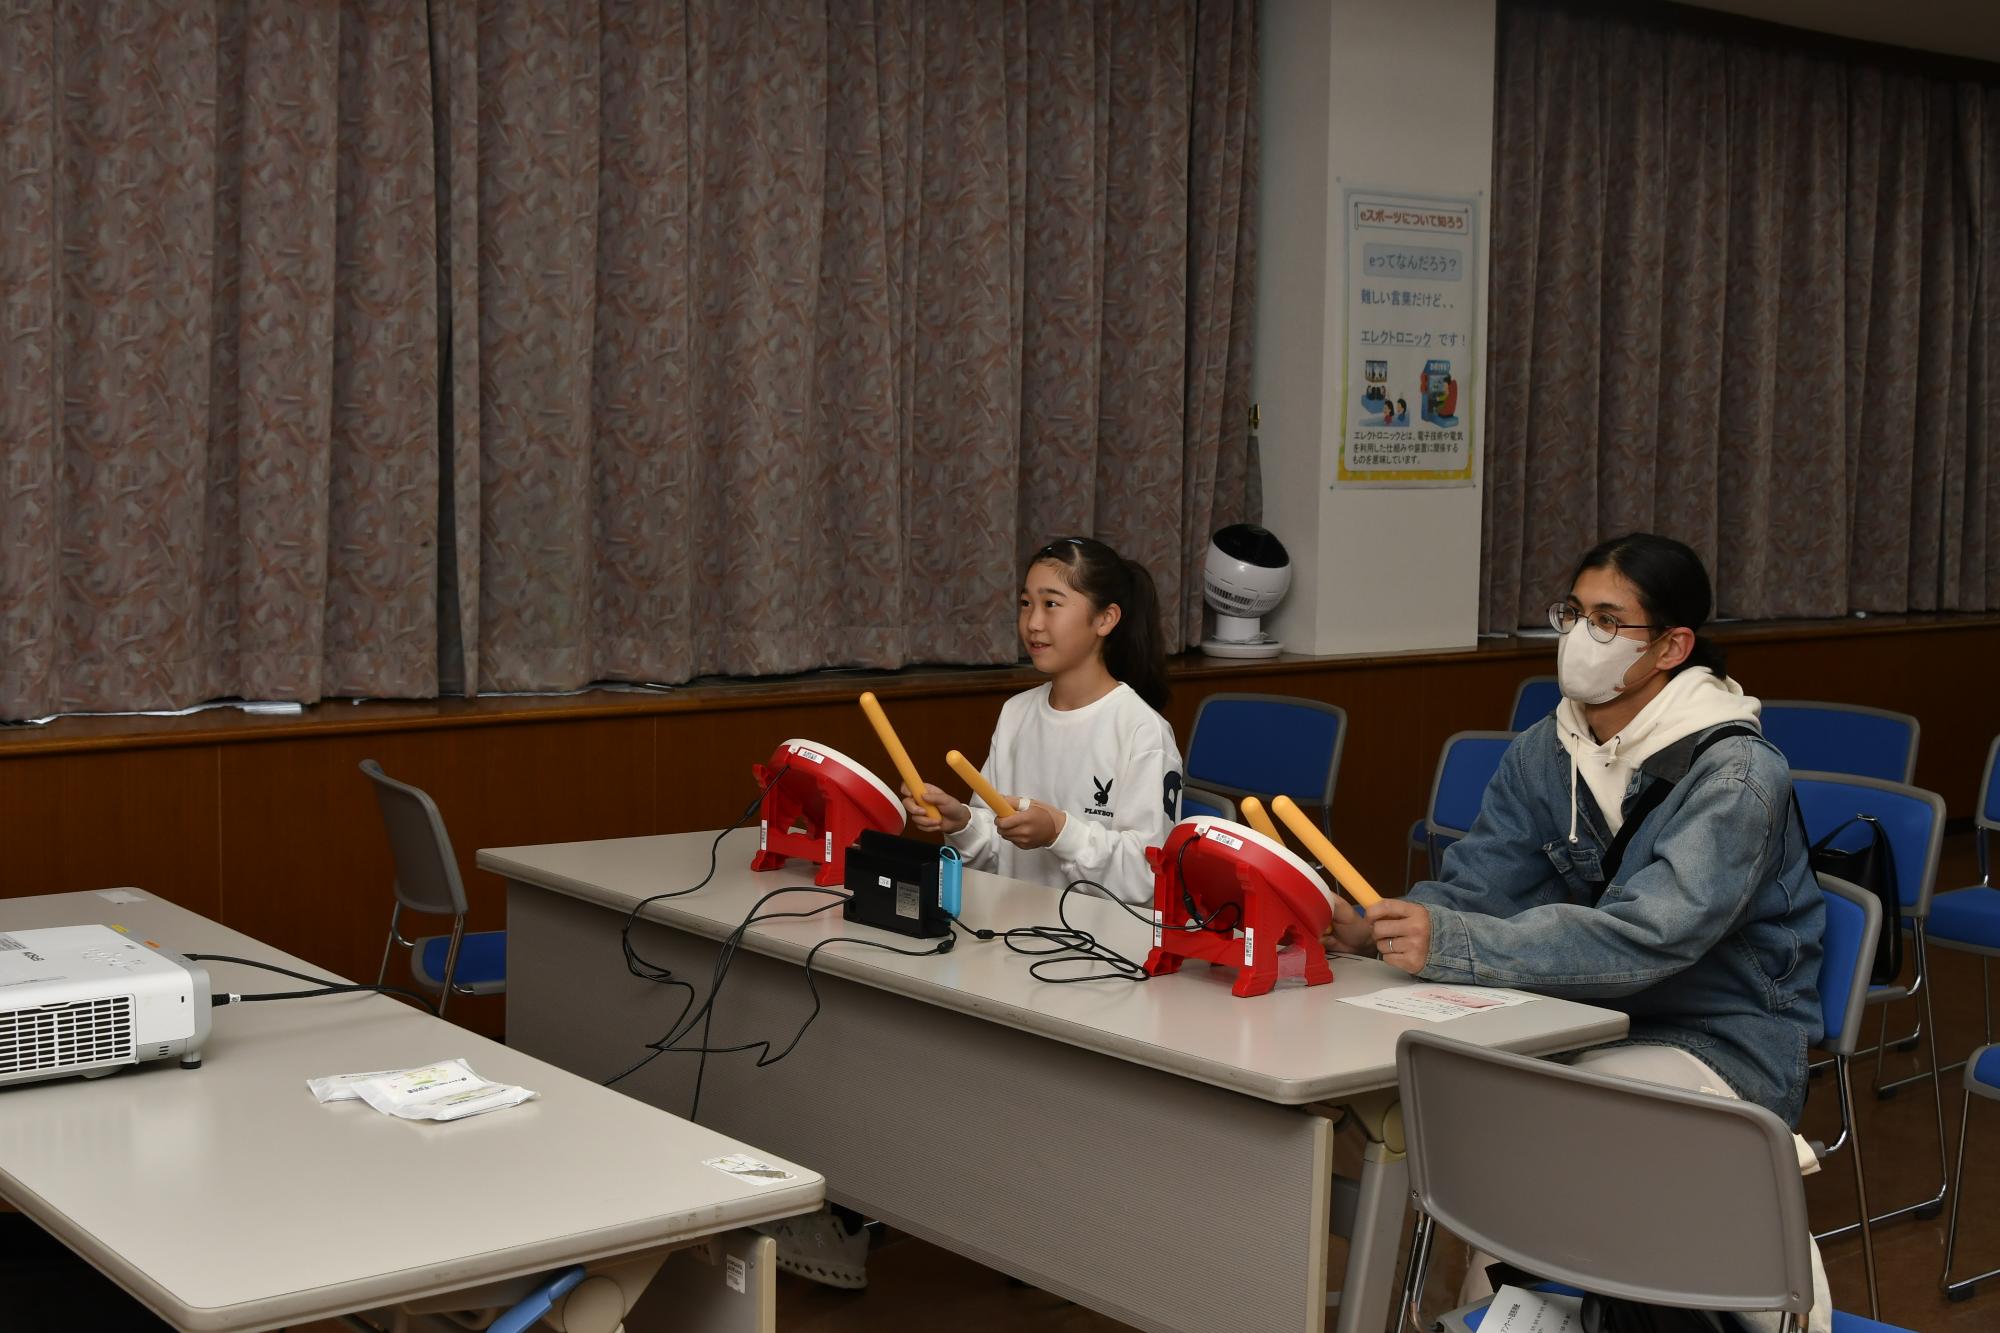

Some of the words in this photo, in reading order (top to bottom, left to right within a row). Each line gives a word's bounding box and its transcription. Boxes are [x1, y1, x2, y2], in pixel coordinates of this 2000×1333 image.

[1360, 209, 1463, 229] eスポーツについて知ろう
[1361, 330, 1431, 346] エレクトロニック
[1084, 808, 1114, 818] PLAYBOY
